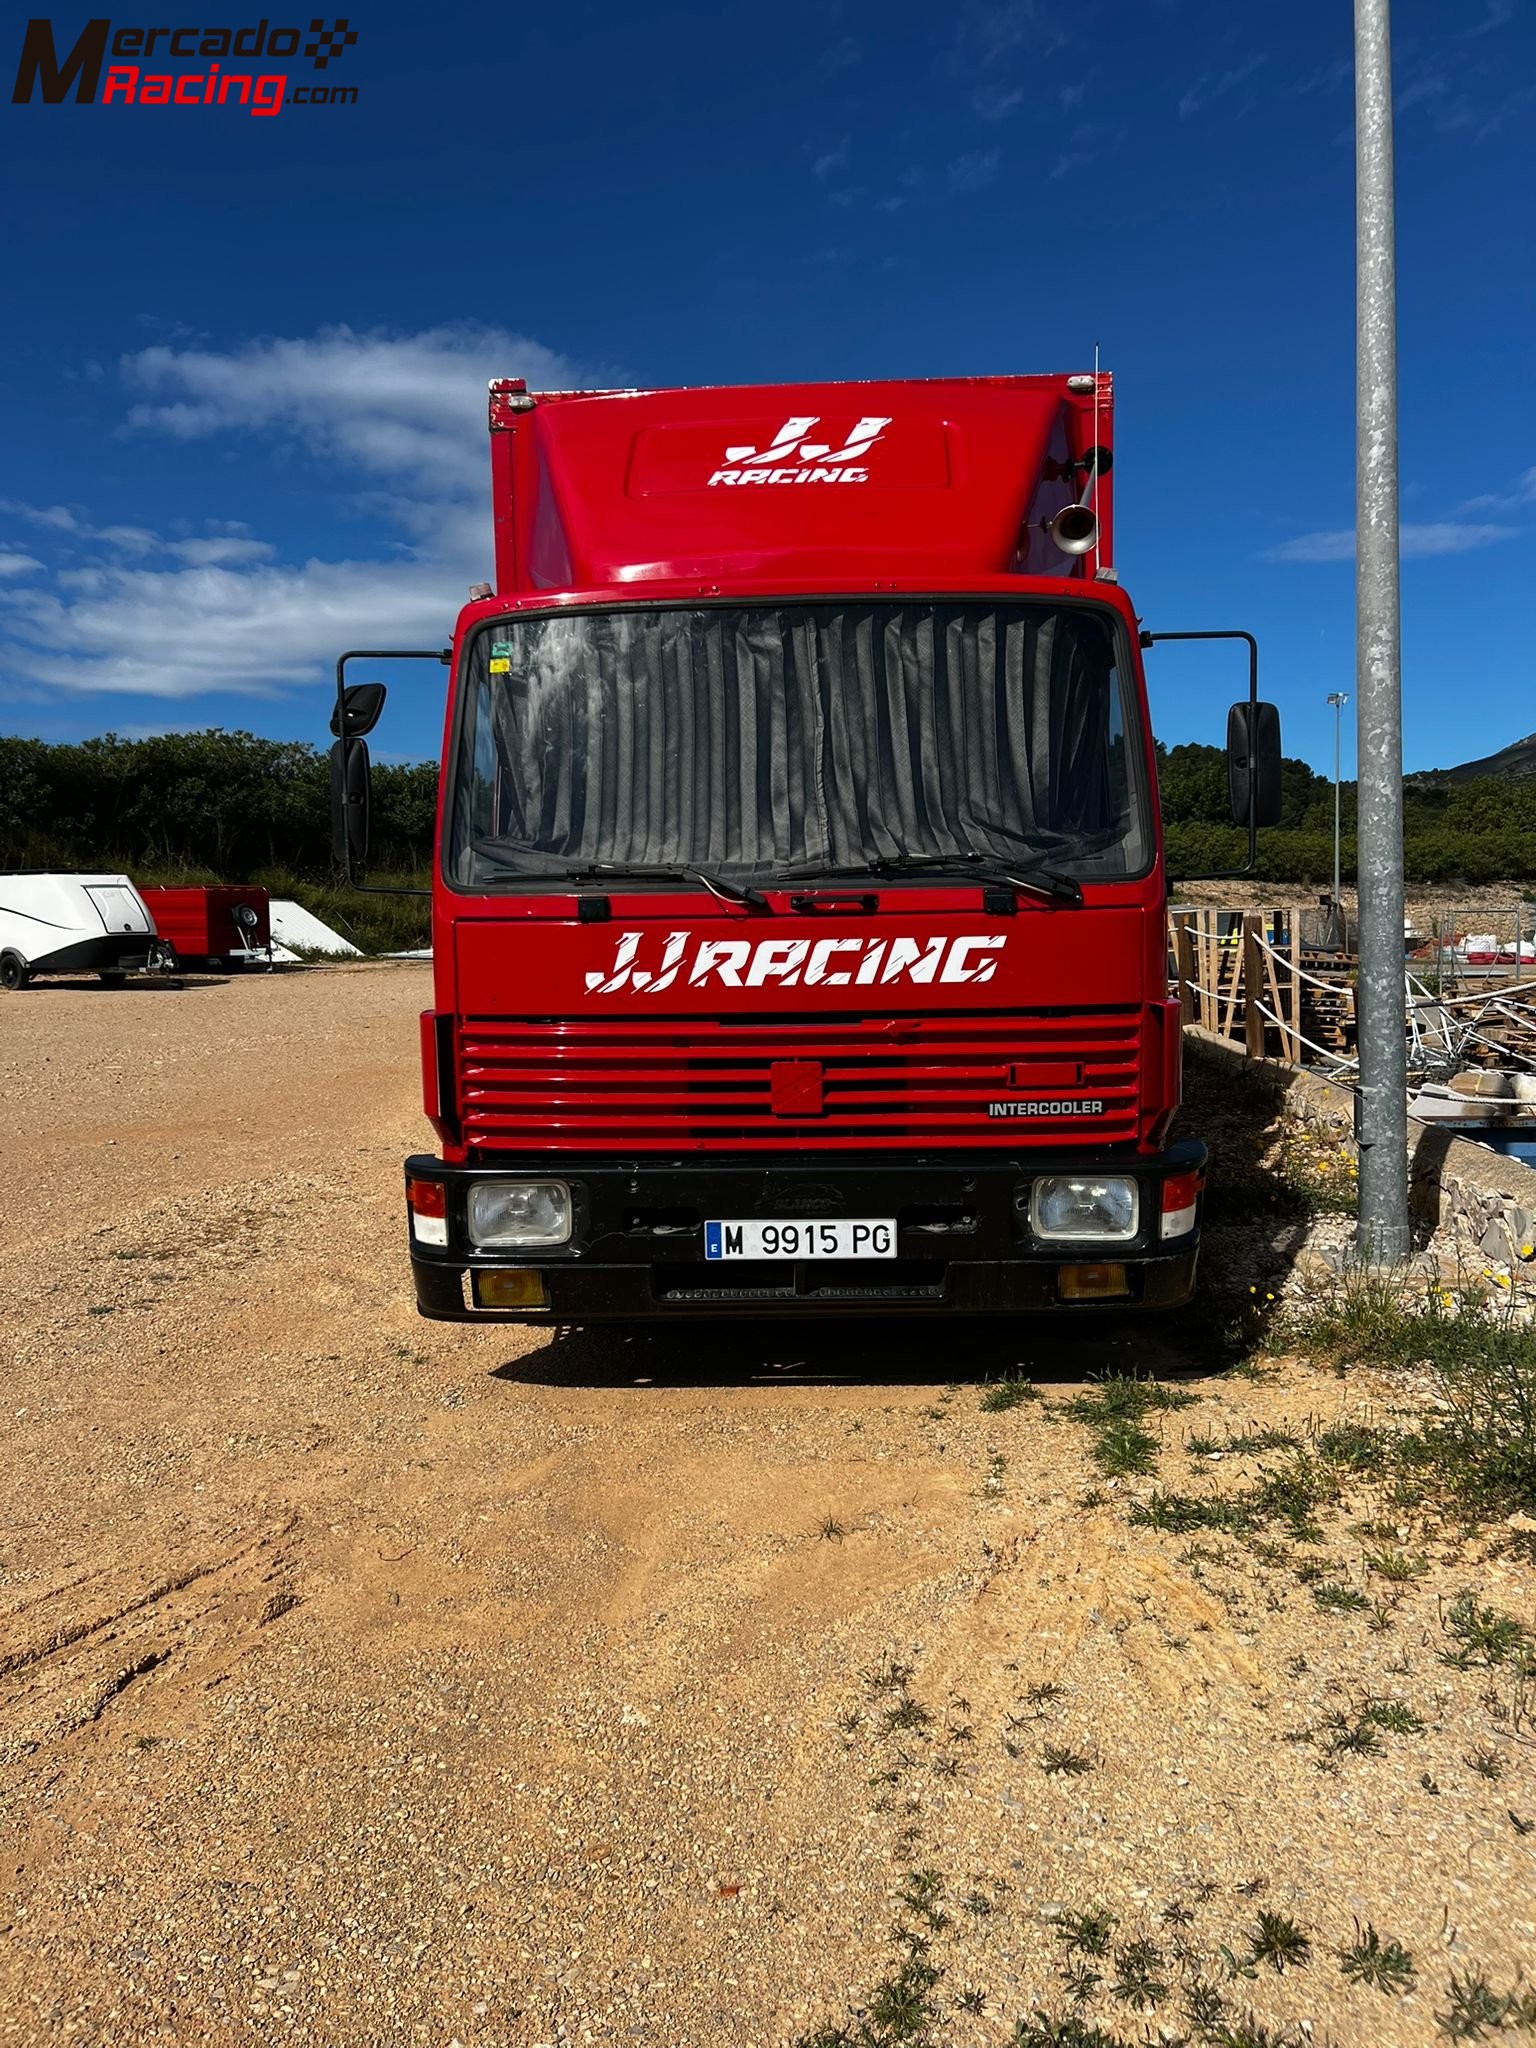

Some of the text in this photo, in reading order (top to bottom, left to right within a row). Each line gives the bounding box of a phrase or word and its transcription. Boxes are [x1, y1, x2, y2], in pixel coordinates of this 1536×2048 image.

[721, 417, 893, 467] JJ
[707, 467, 870, 487] RACING
[988, 1101, 1103, 1116] INTERCOOLER
[711, 1225, 891, 1254] E M 9915 PG
